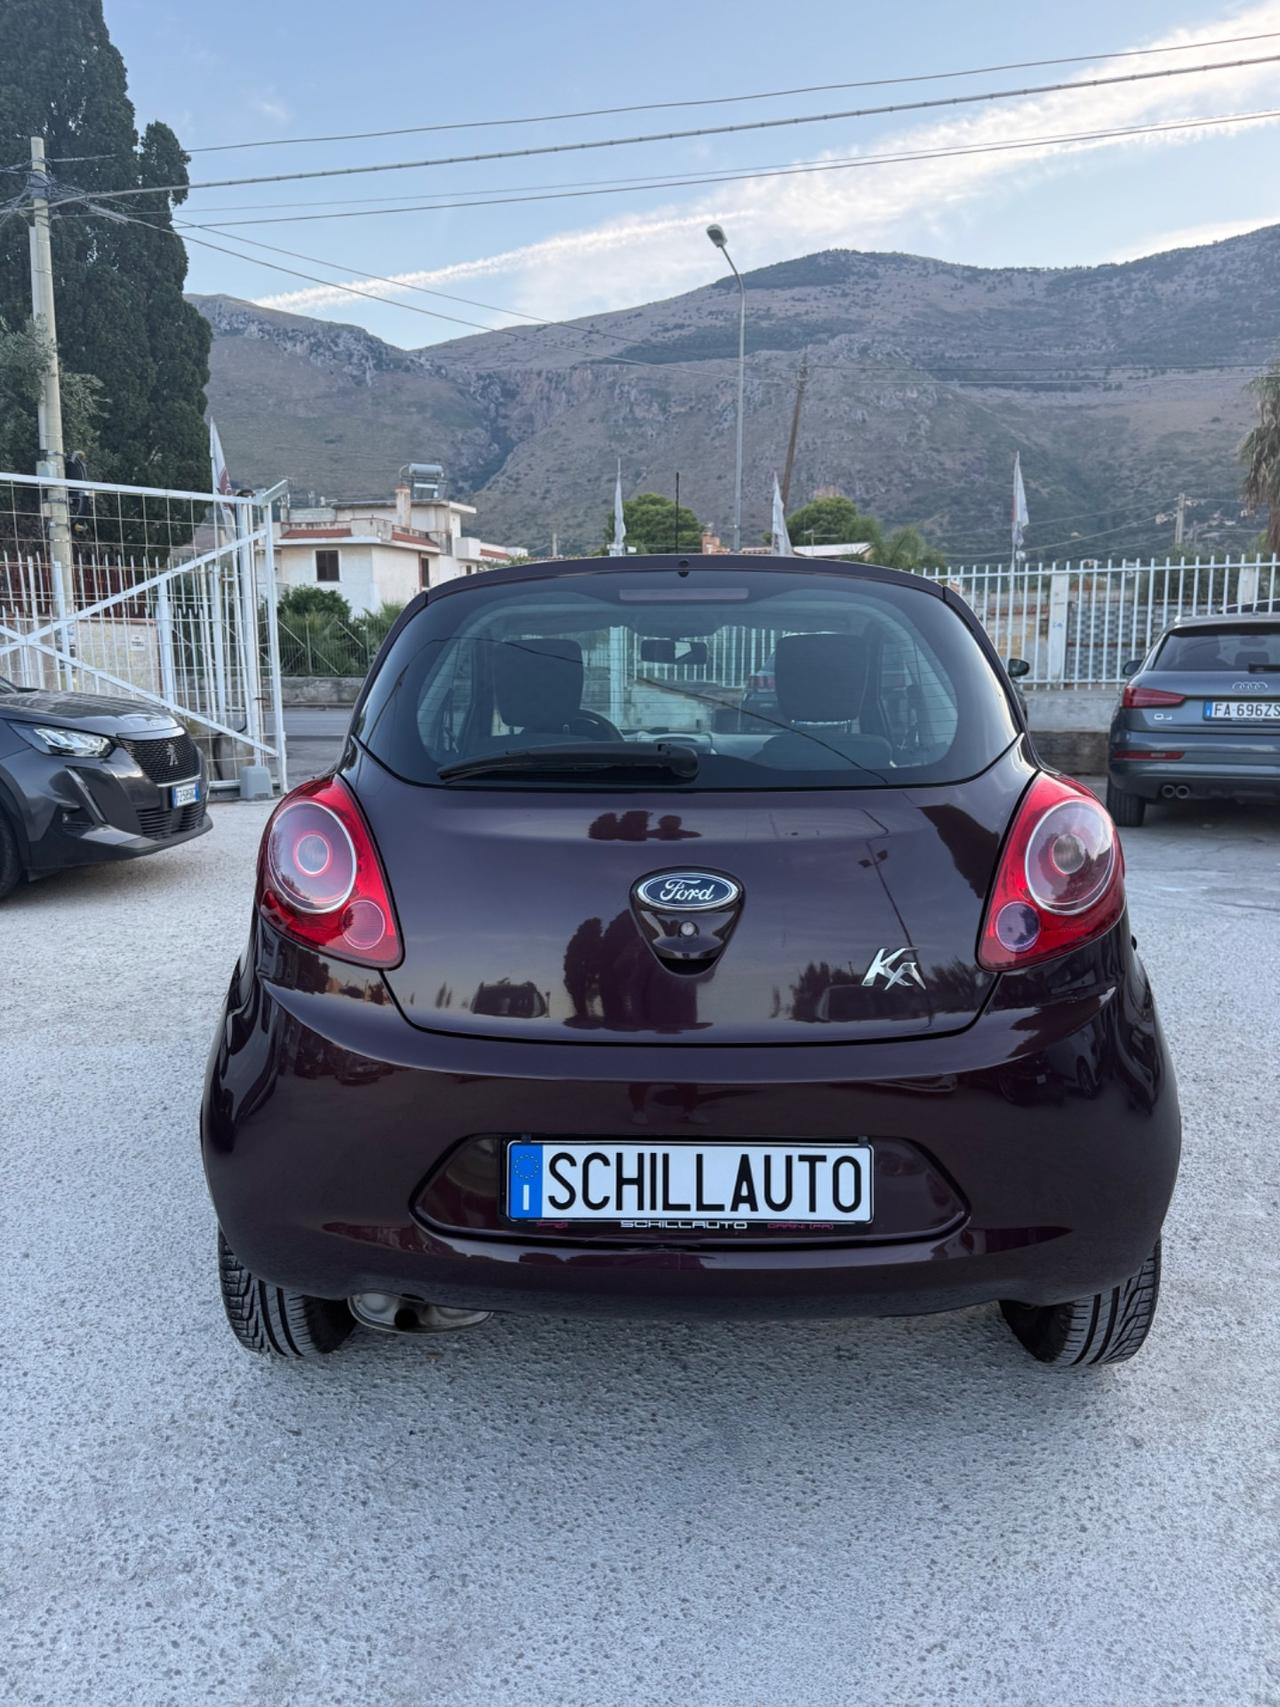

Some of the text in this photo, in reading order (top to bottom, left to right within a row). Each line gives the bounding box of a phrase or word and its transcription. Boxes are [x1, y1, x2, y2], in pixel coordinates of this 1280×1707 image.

[1214, 703, 1231, 717] FA
[659, 878, 717, 902] Ford
[547, 1151, 863, 1214] SCHILLAUTO
[620, 1219, 748, 1230] SCHILLAUTO
